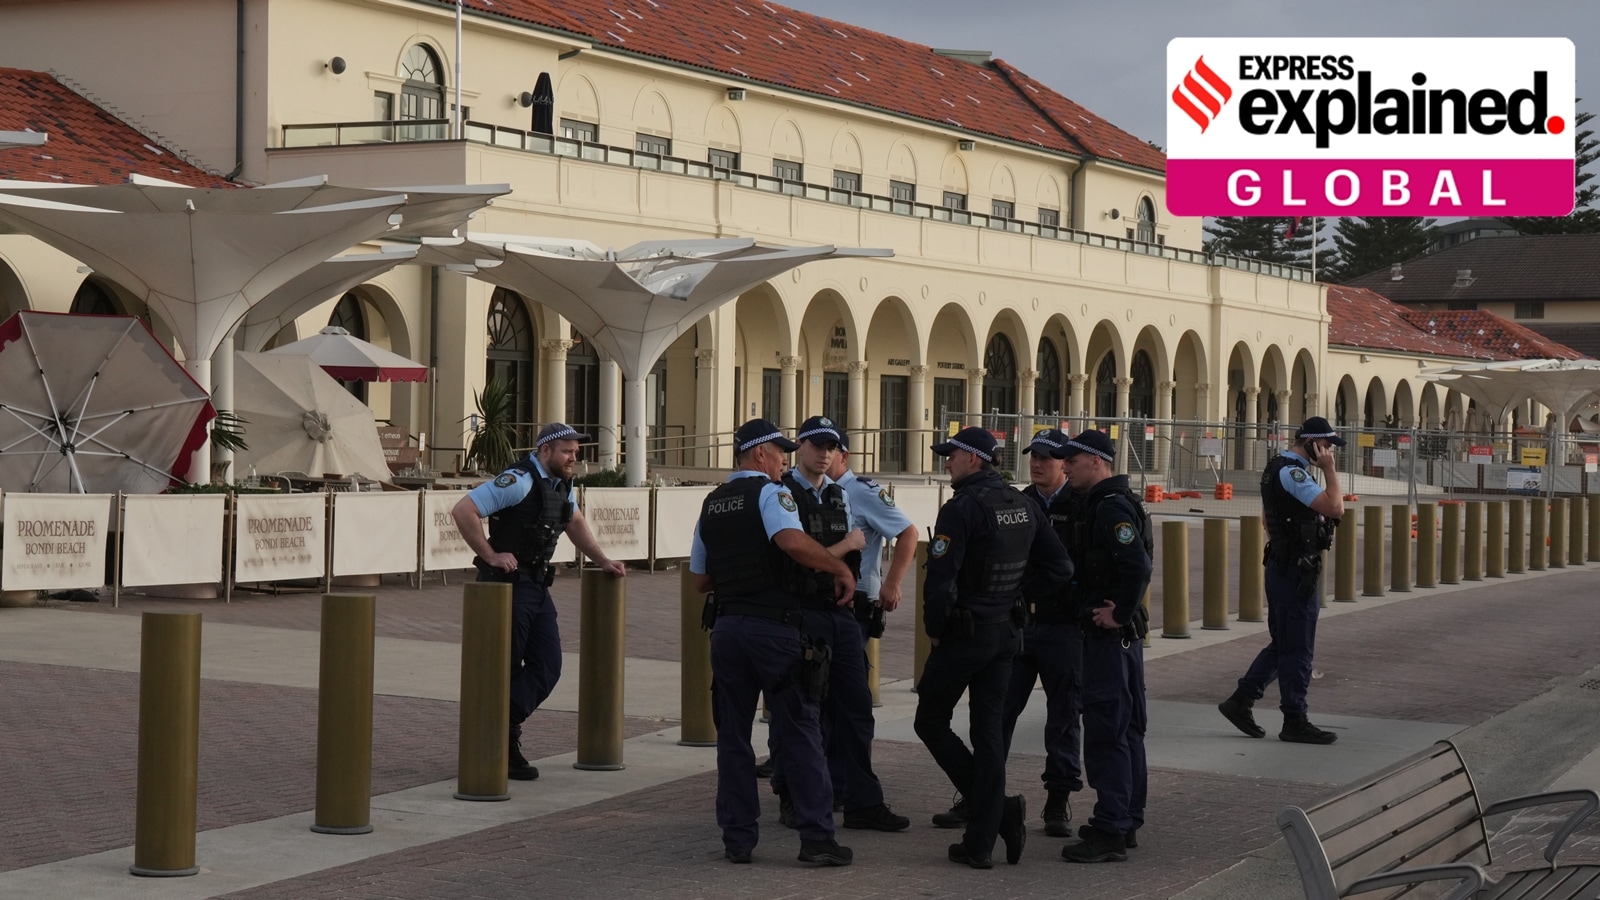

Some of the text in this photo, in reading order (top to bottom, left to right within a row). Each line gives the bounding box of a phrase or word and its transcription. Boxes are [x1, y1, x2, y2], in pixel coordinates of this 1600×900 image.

[593, 507, 640, 521] PROMENADE
[708, 499, 744, 515] POLICE
[247, 516, 313, 534] PROMENADE
[996, 512, 1029, 525] POLICE
[17, 520, 95, 537] PROMENADE
[25, 542, 86, 555] BONDI BEACH
[255, 536, 305, 550] BONDI BEACH
